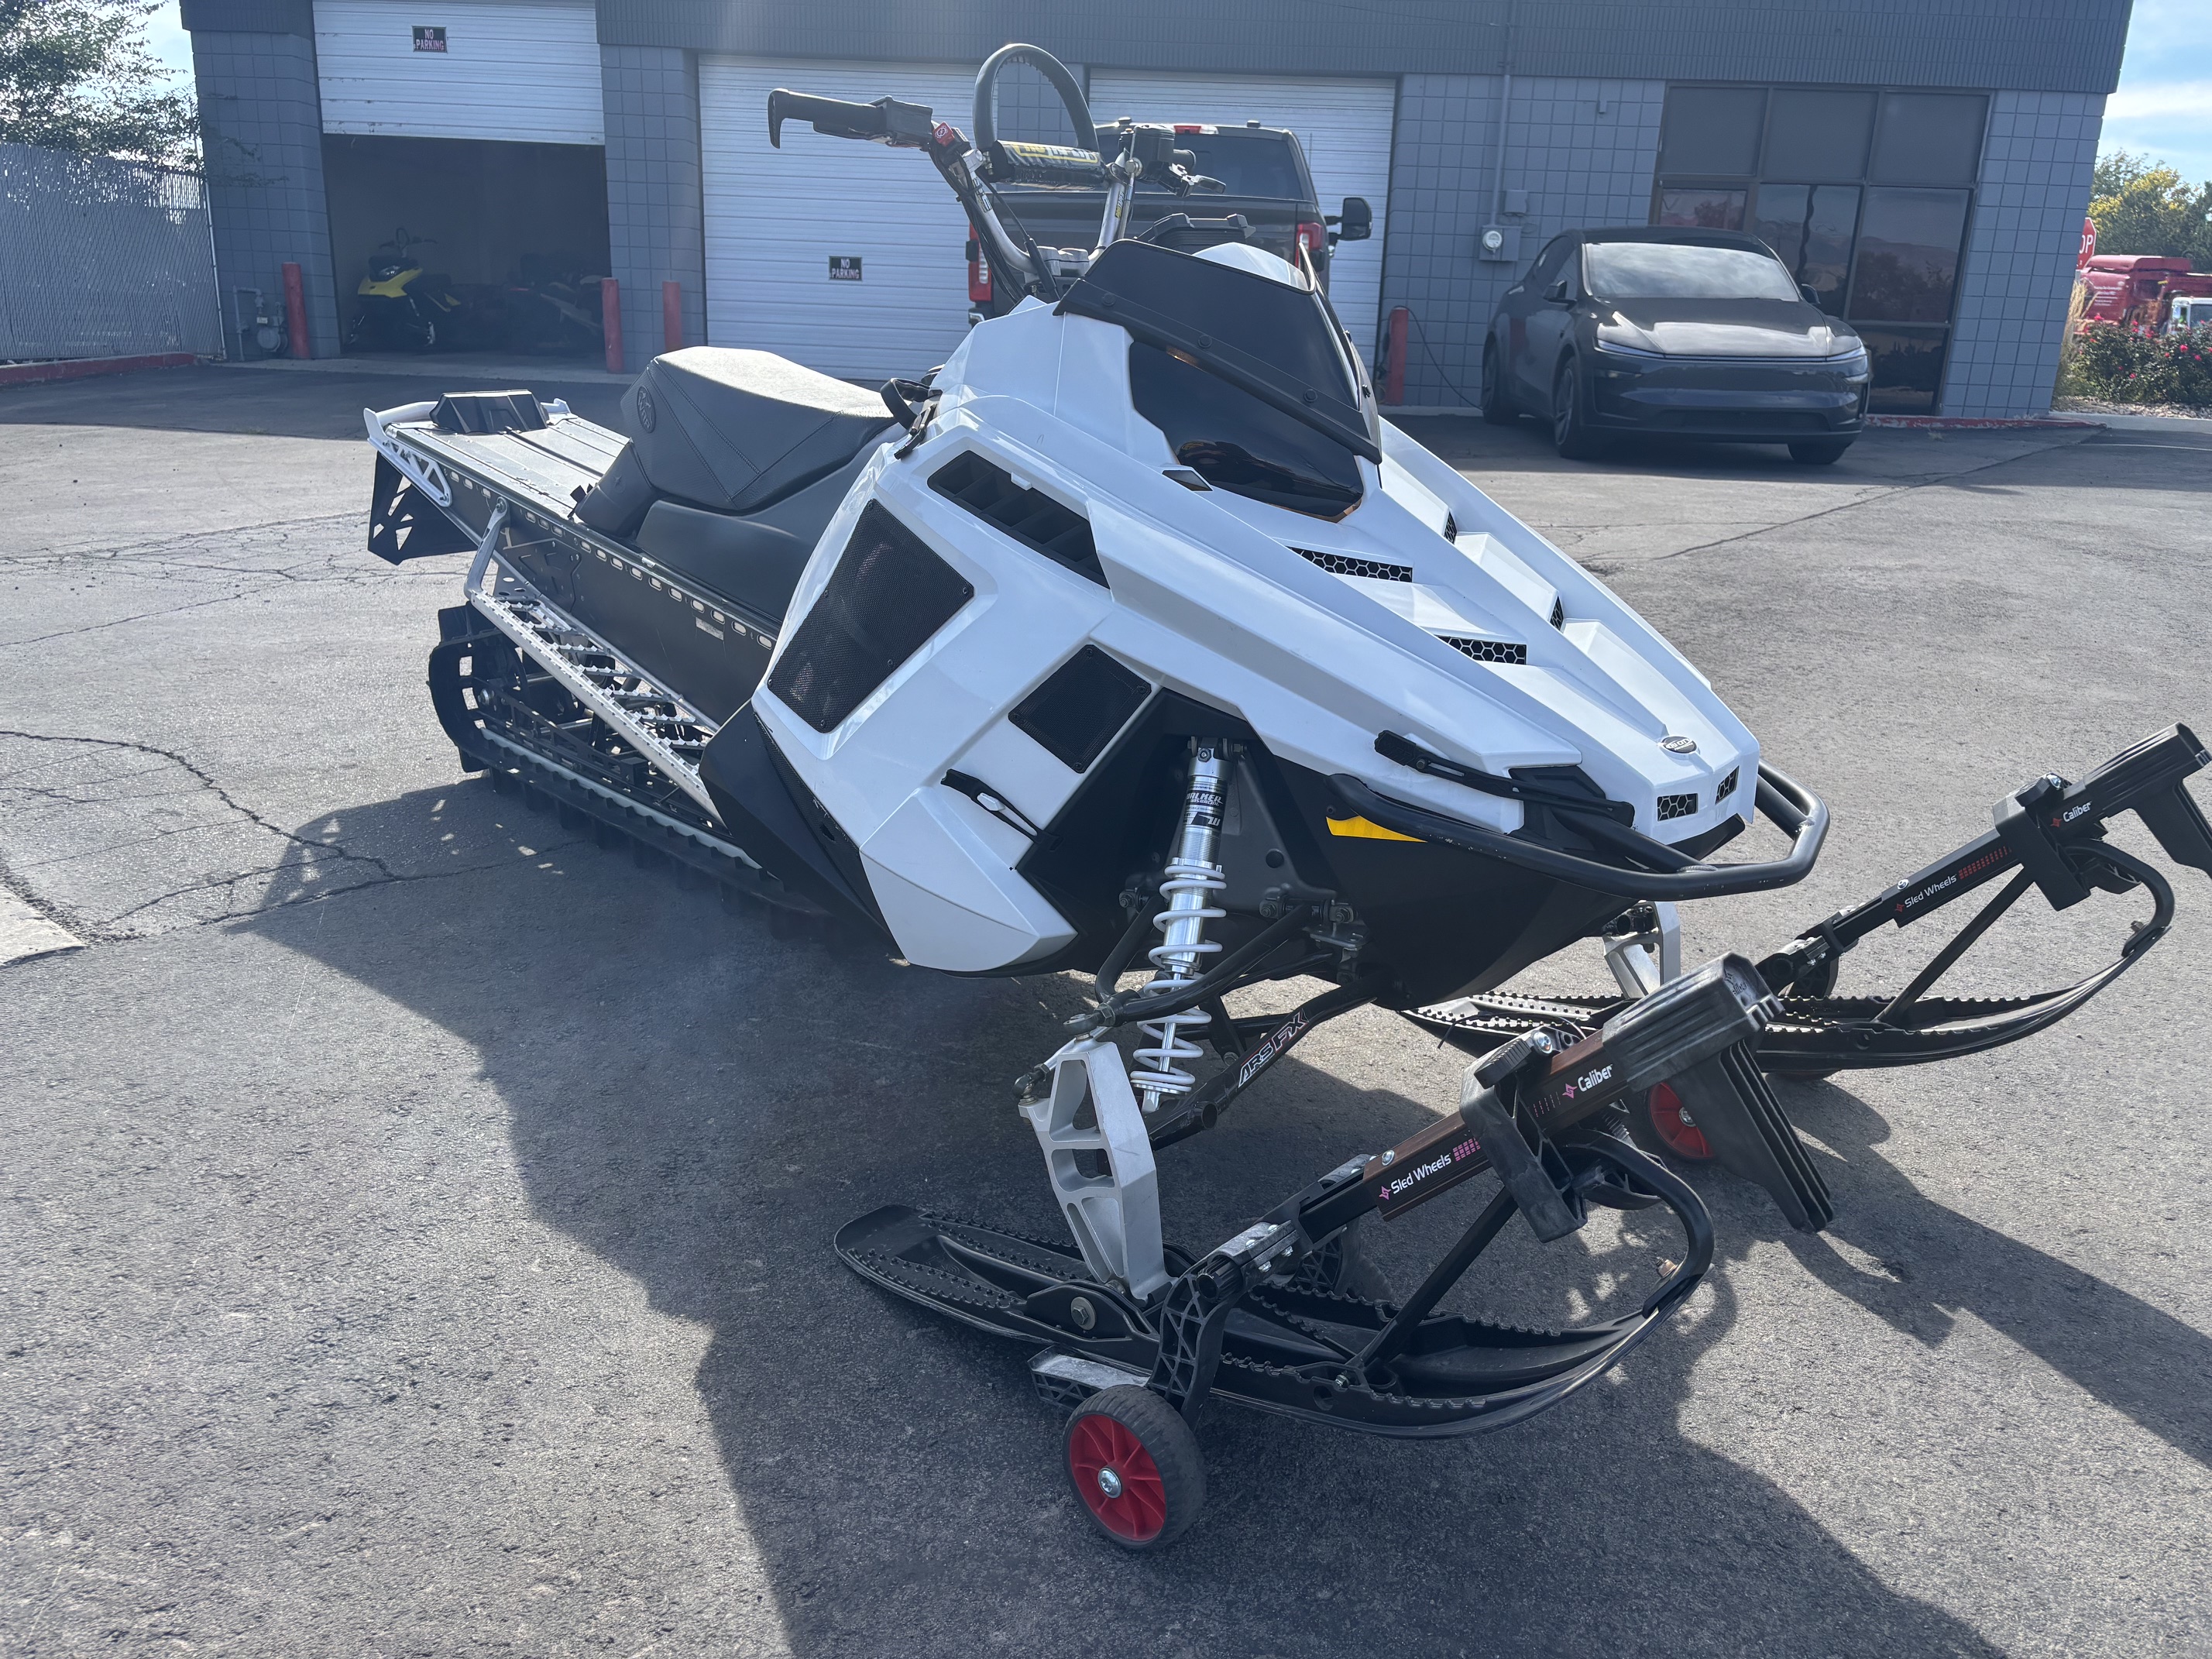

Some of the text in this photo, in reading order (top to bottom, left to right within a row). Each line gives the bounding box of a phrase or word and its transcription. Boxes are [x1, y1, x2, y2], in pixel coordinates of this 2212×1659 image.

[424, 29, 434, 39] NO
[416, 39, 445, 50] PARKING
[2079, 234, 2094, 254] OP
[831, 268, 860, 279] PARKING
[840, 259, 850, 269] NO
[2063, 802, 2091, 823] Caliber
[1905, 875, 1956, 908] Sled Wheels
[1578, 1066, 1613, 1092] Caliber
[1390, 1154, 1451, 1194] Sled Wheels
